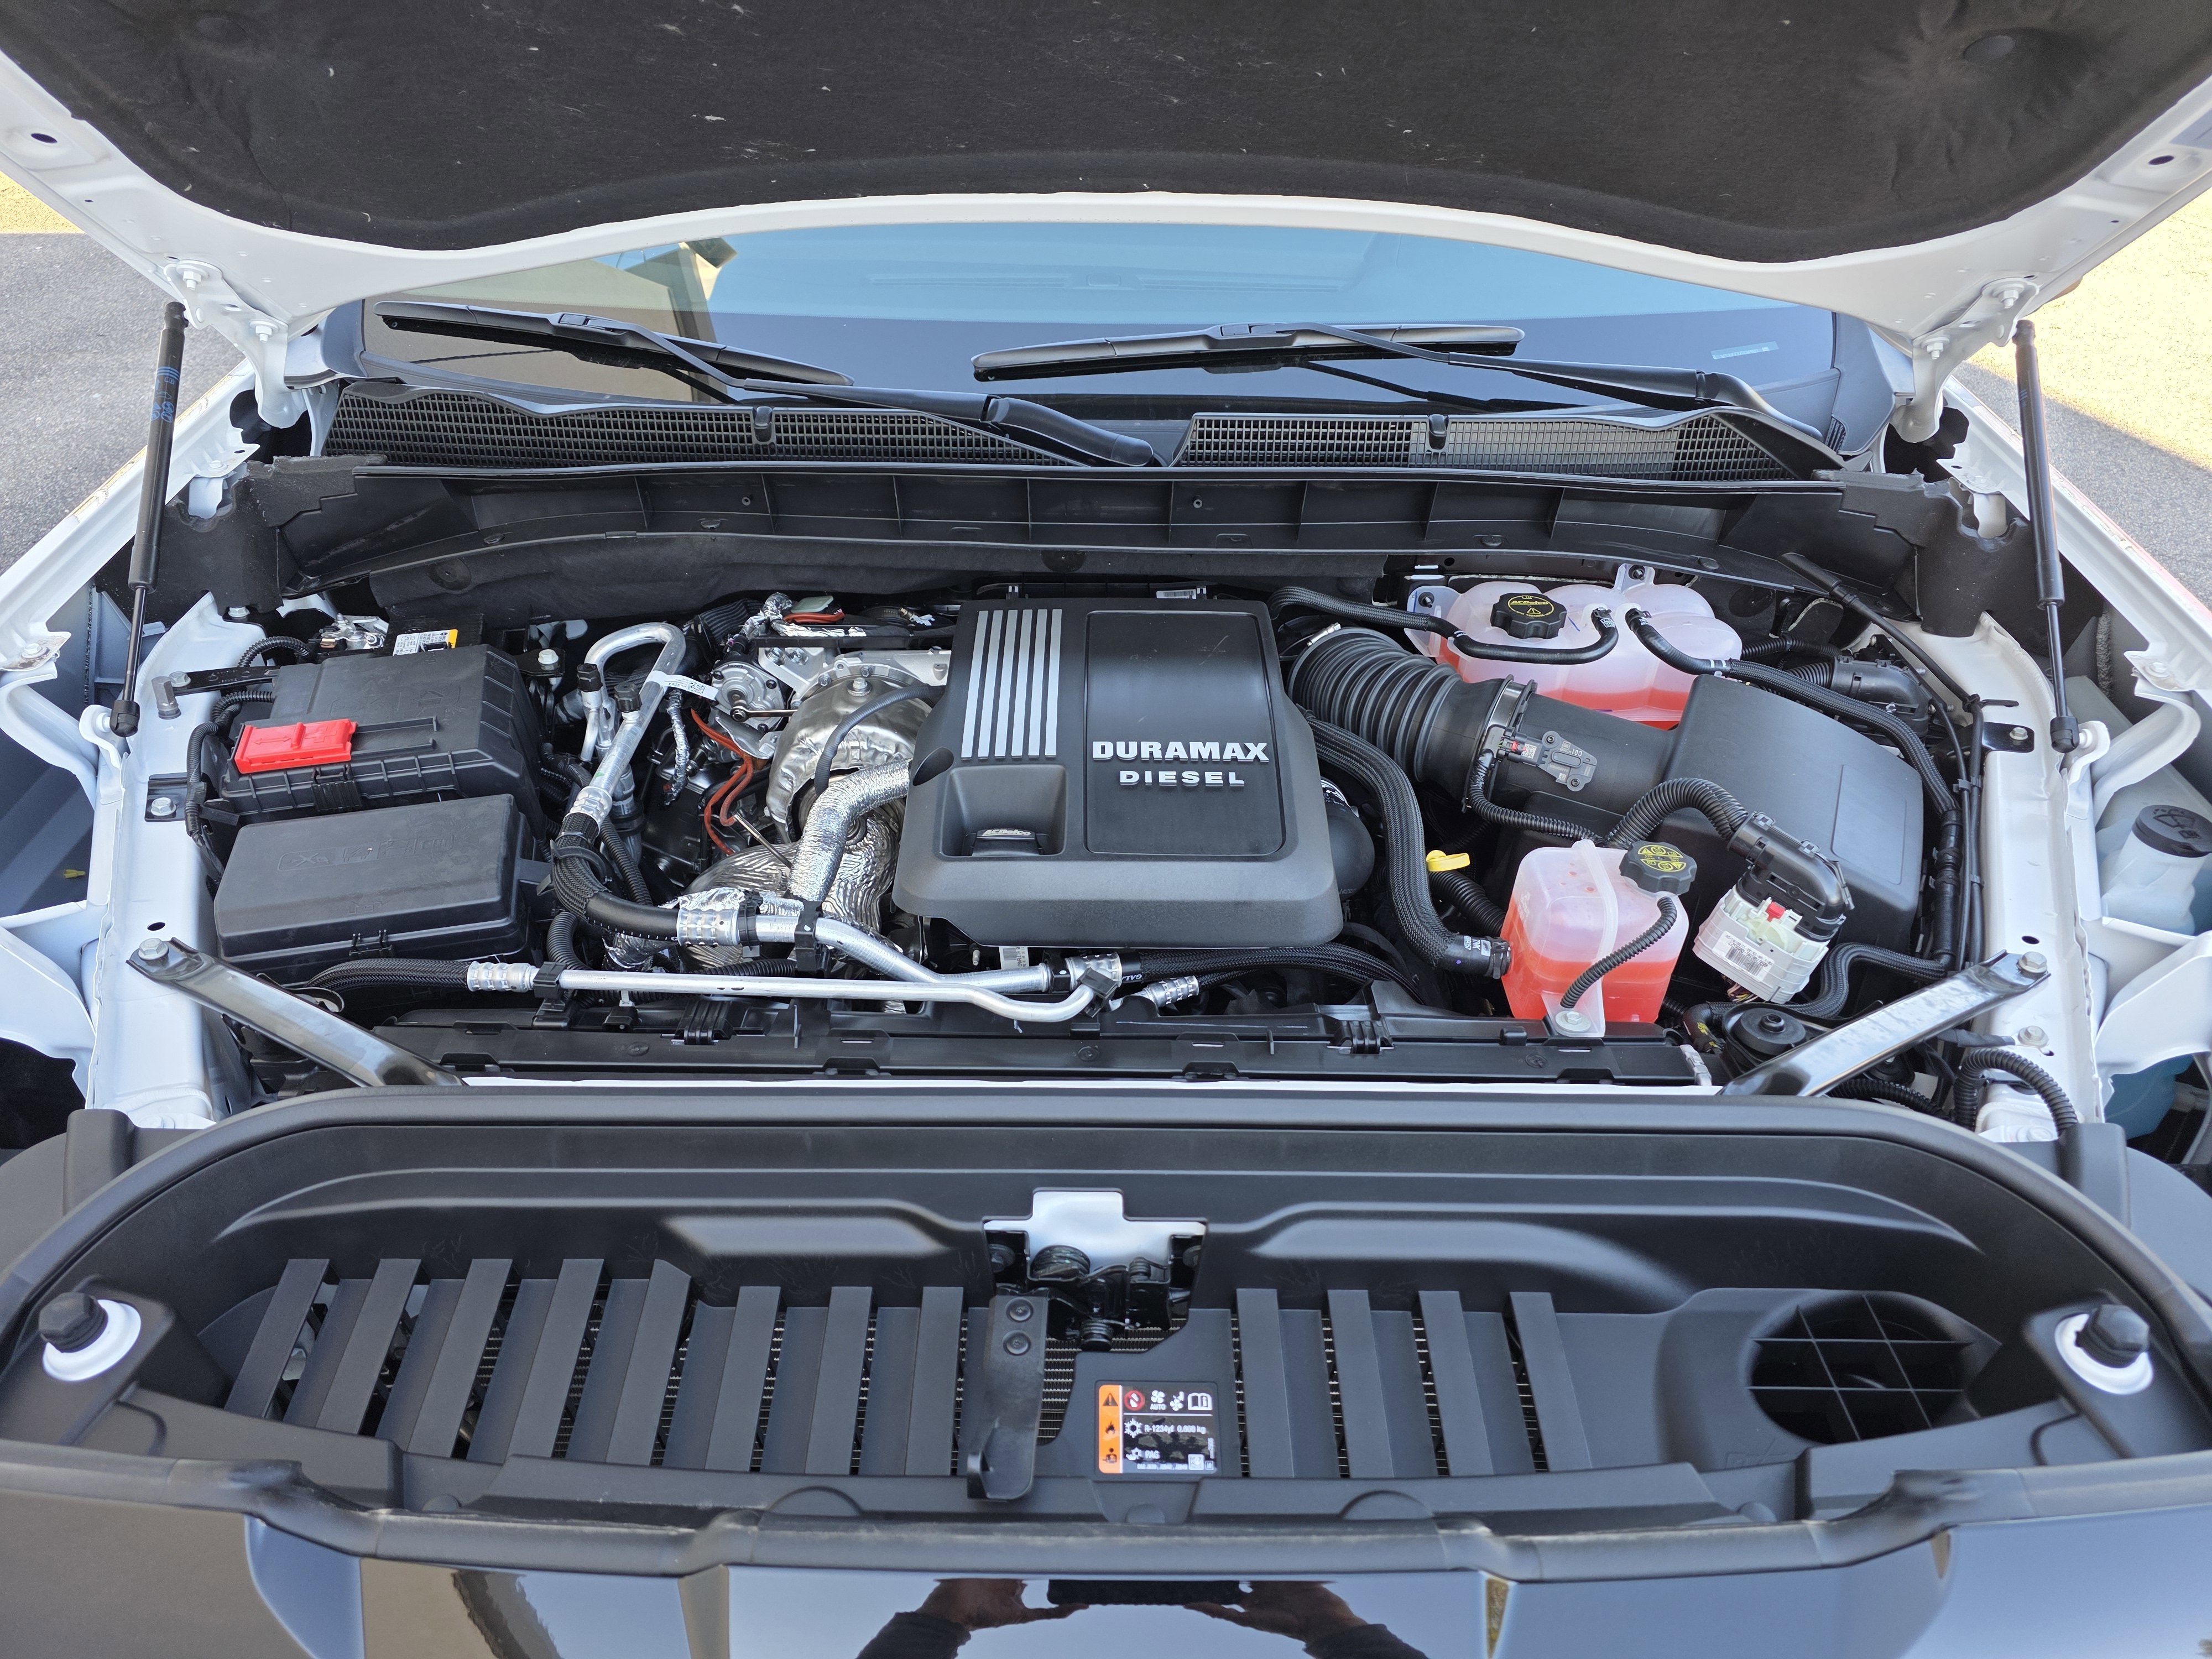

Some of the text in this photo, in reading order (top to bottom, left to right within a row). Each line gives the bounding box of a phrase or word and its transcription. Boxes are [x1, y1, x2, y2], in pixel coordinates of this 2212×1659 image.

[1093, 741, 1269, 762] DURAMAX
[1120, 770, 1245, 786] DIESEL
[1144, 1425, 1174, 1434] R-1234yf
[1197, 1425, 1207, 1434] kg
[1145, 1450, 1160, 1459] PAG
